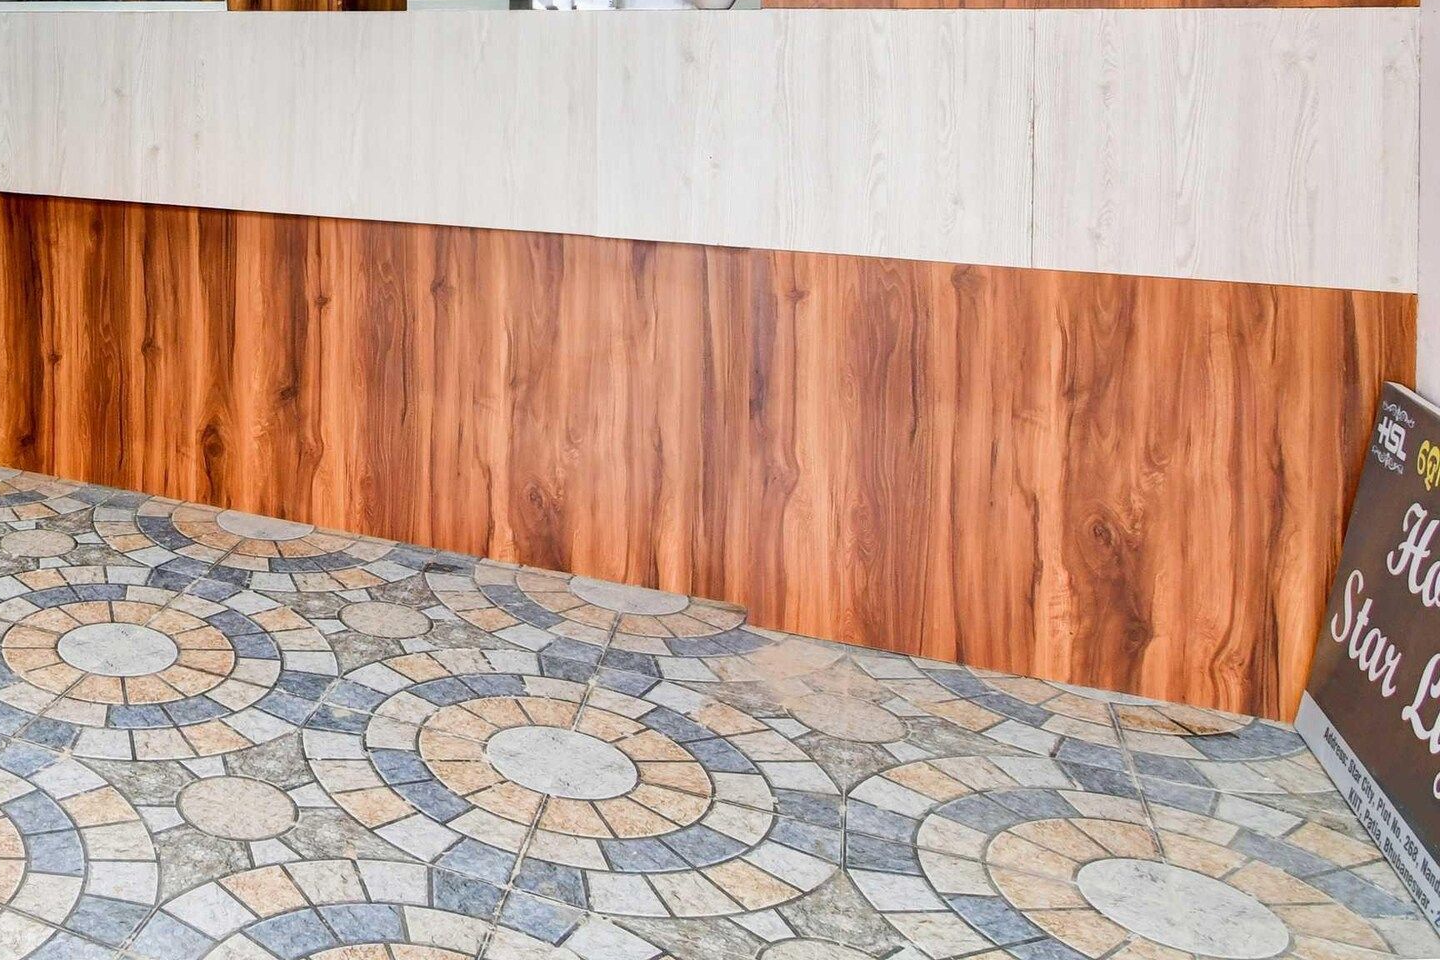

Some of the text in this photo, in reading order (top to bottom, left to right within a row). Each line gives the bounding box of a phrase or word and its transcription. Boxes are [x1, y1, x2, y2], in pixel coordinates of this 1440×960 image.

[1377, 416, 1407, 461] HSL
[1331, 569, 1402, 698] Star
[1348, 759, 1362, 784] Star
[1377, 797, 1391, 826] Plot
[1391, 817, 1402, 842] No.
[1383, 836, 1430, 910] Bhubaneswar
